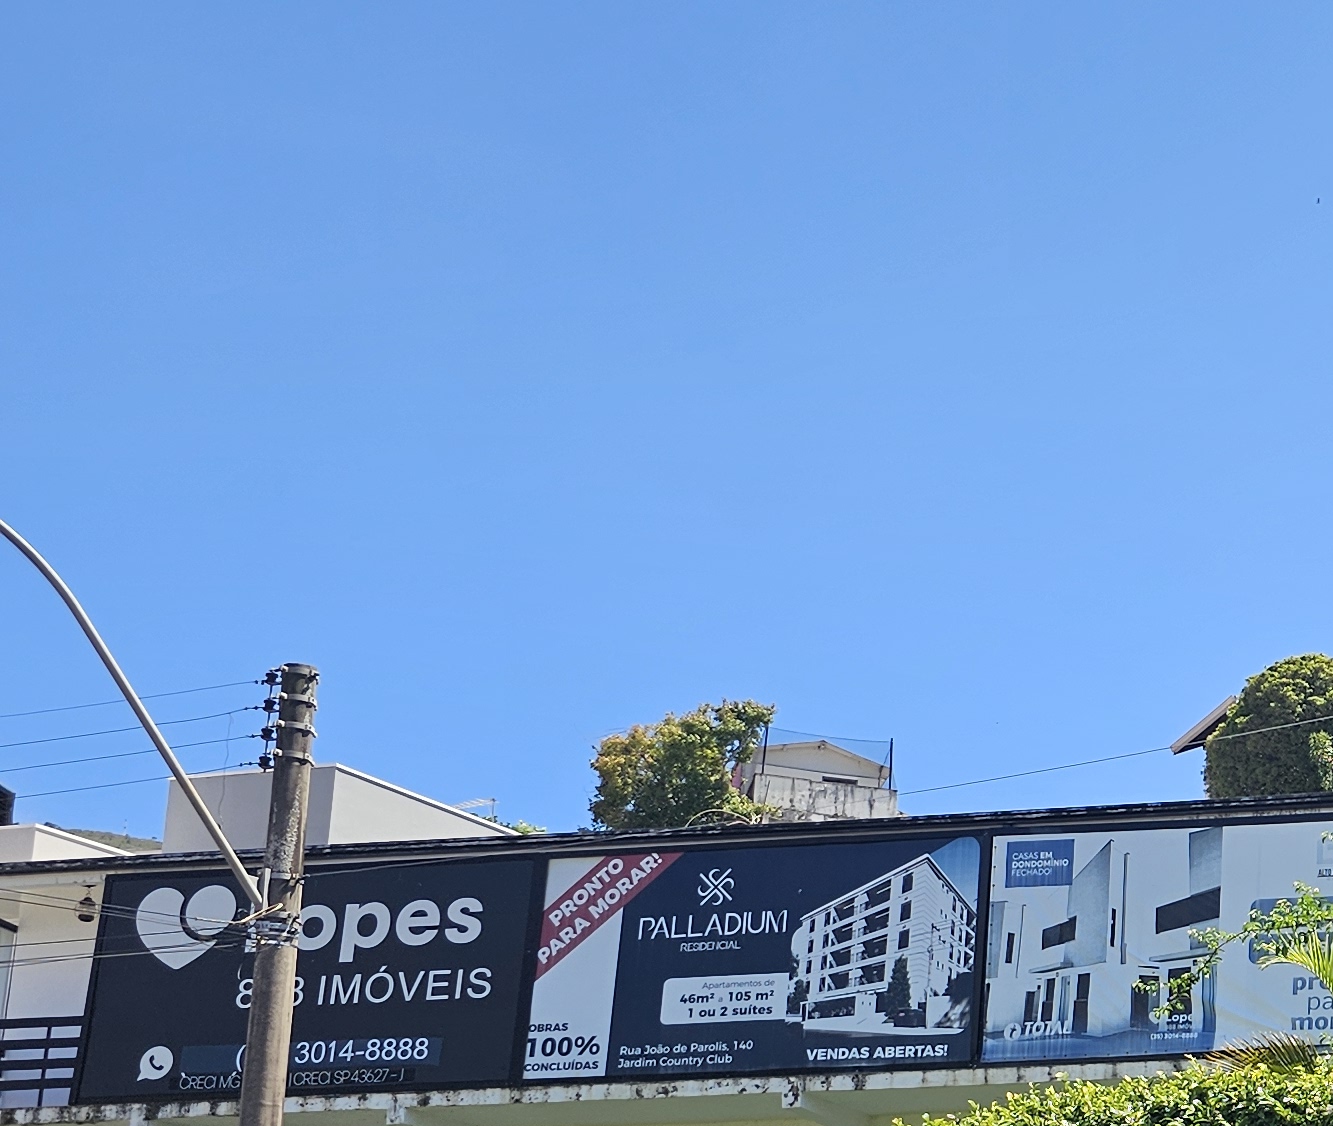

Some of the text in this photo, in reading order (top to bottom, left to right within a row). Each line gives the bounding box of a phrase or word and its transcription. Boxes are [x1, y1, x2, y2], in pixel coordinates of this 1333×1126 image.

[1012, 851, 1053, 861] CASAS EM
[548, 858, 624, 927] PRONTO
[537, 852, 663, 965] PARA MORAR!
[637, 909, 788, 940] PALLADIUM
[316, 964, 493, 1006] IMÓVEIS
[701, 979, 775, 991] Apartamentos de
[727, 991, 752, 1002] 105
[688, 1004, 773, 1018] 1 ou 2 suítes
[528, 1022, 569, 1033] OBRAS
[1023, 1020, 1073, 1036] TOTAL
[294, 1037, 429, 1065] 3014-8888
[527, 1035, 601, 1057] 100%
[619, 1040, 754, 1056] Rua João de Parolis, 140
[806, 1044, 949, 1061] VENDAS ABERTAS!
[523, 1059, 599, 1072] CONCLUÍDAS
[617, 1053, 733, 1069] Jardim Country Club
[179, 1074, 241, 1090] CRECI MG
[293, 1071, 331, 1086] CRECI
[333, 1070, 350, 1085] SP
[350, 1068, 390, 1084] 43627
